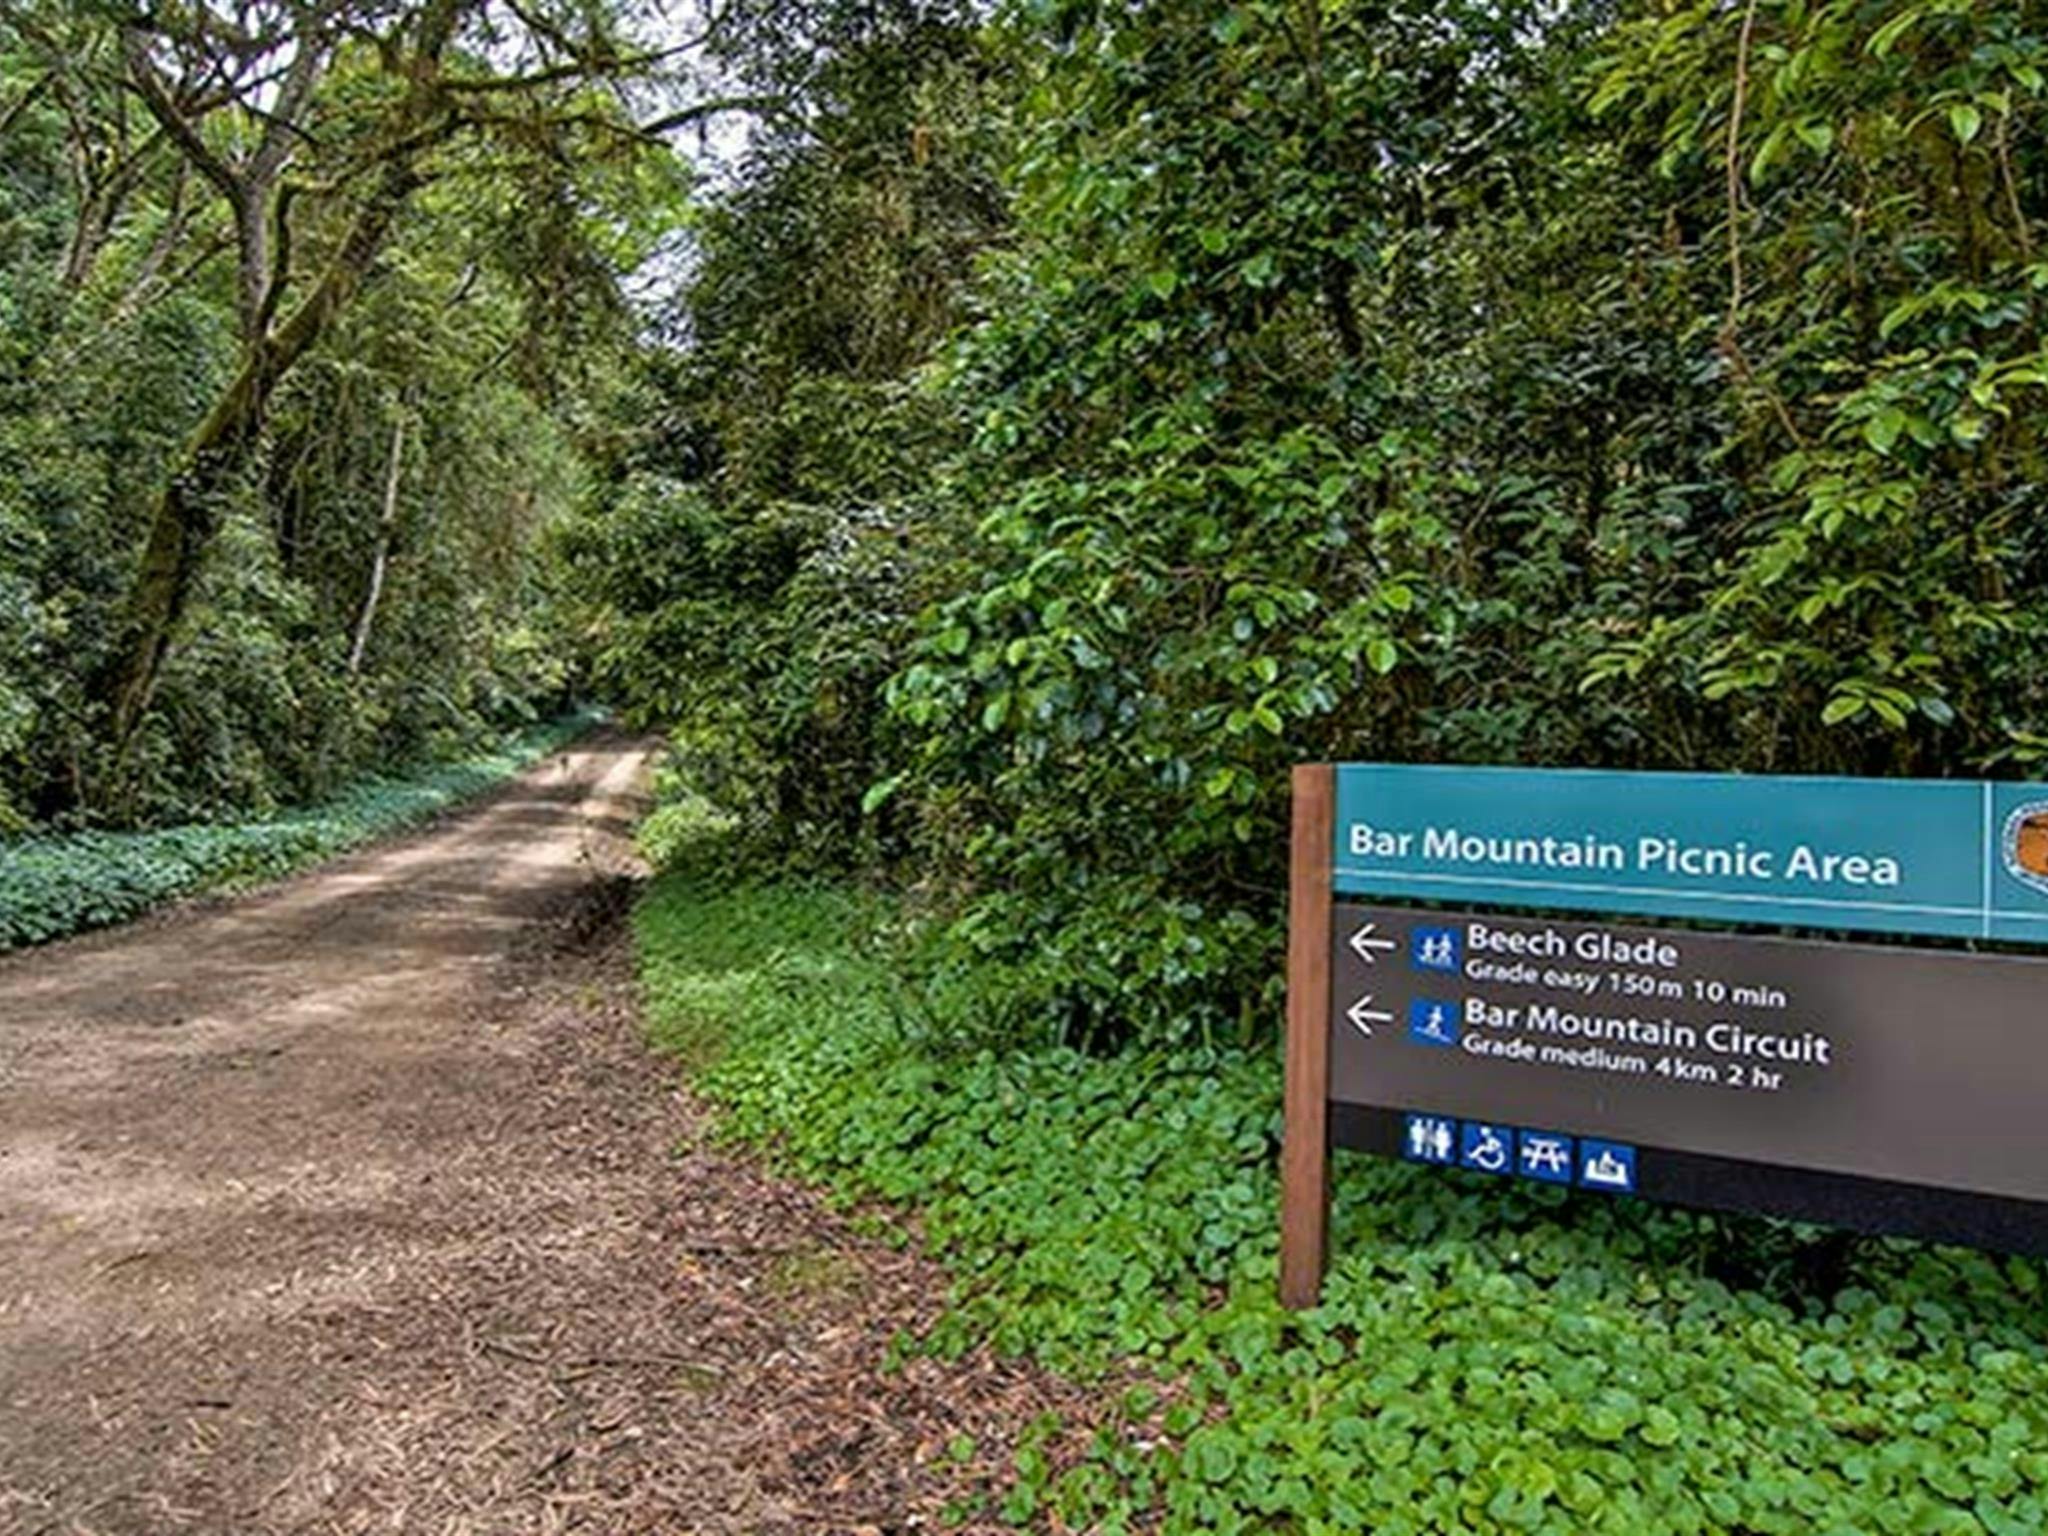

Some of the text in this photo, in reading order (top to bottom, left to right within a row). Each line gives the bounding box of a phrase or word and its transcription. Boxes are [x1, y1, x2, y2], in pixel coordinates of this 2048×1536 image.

[1350, 825, 1899, 885] Bar Mountain Picnic Area
[1467, 923, 1677, 967] Beech Glade
[1466, 960, 1786, 1007] Grade easy 150m 10 min
[1465, 999, 1830, 1064] Bar Mountain Circuit
[1463, 1035, 1782, 1090] Grade medium 4km 2 hr
